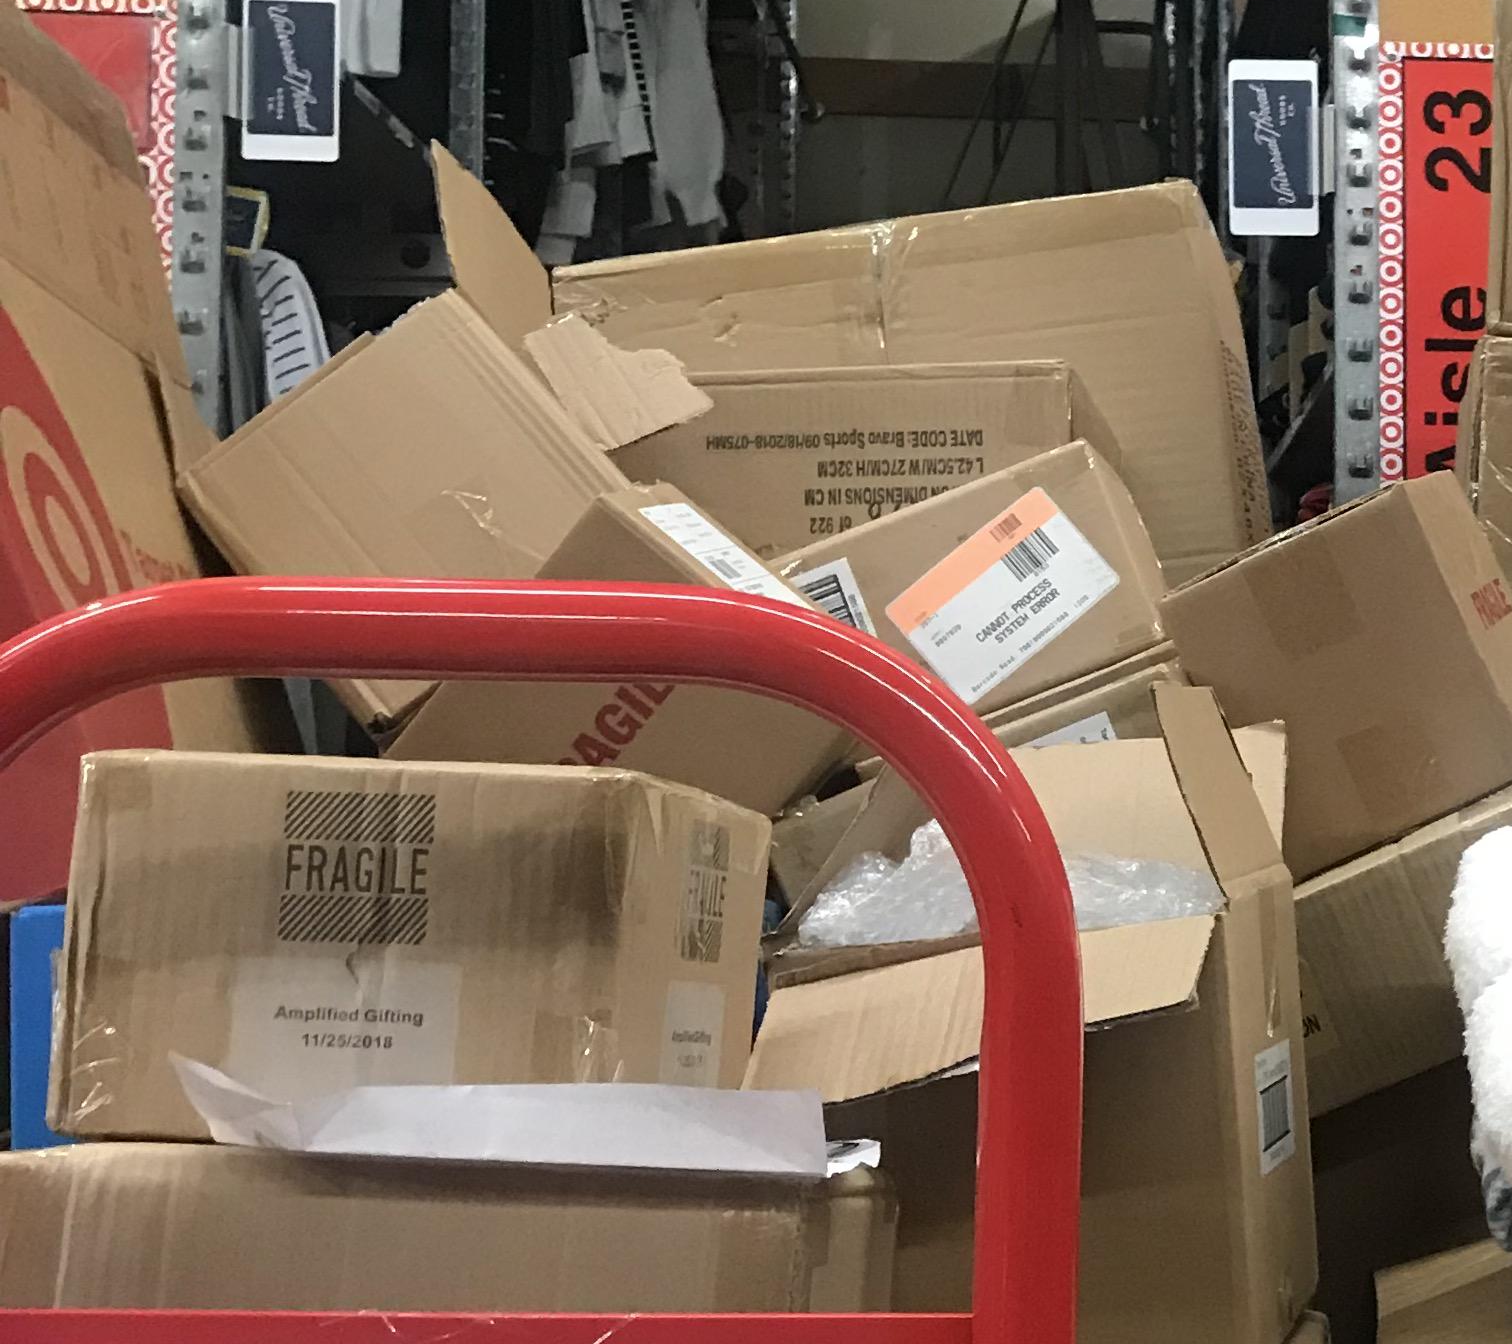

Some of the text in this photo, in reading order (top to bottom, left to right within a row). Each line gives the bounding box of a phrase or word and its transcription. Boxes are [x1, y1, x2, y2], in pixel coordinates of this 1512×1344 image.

[1423, 89, 1493, 194] 23
[1264, 138, 1297, 205] Universal
[824, 428, 865, 450] Sports
[868, 431, 904, 448] Bravo
[907, 431, 948, 448] CODE:
[950, 429, 983, 447] DATE
[818, 460, 853, 478] 32CM
[976, 457, 984, 474] L
[804, 489, 824, 505] CM
[828, 488, 841, 505] IN
[845, 486, 927, 505] DIMENSIONS
[810, 517, 833, 534] 922
[976, 612, 1010, 643] CANNOT
[1012, 578, 1052, 613] PROCESS
[994, 613, 1029, 644] SYSTEM
[1031, 588, 1060, 614] ERROR
[285, 844, 430, 895] FRAGILE
[273, 1005, 424, 1027] Amplified Gifting
[301, 1032, 393, 1049] 11/25/2018
